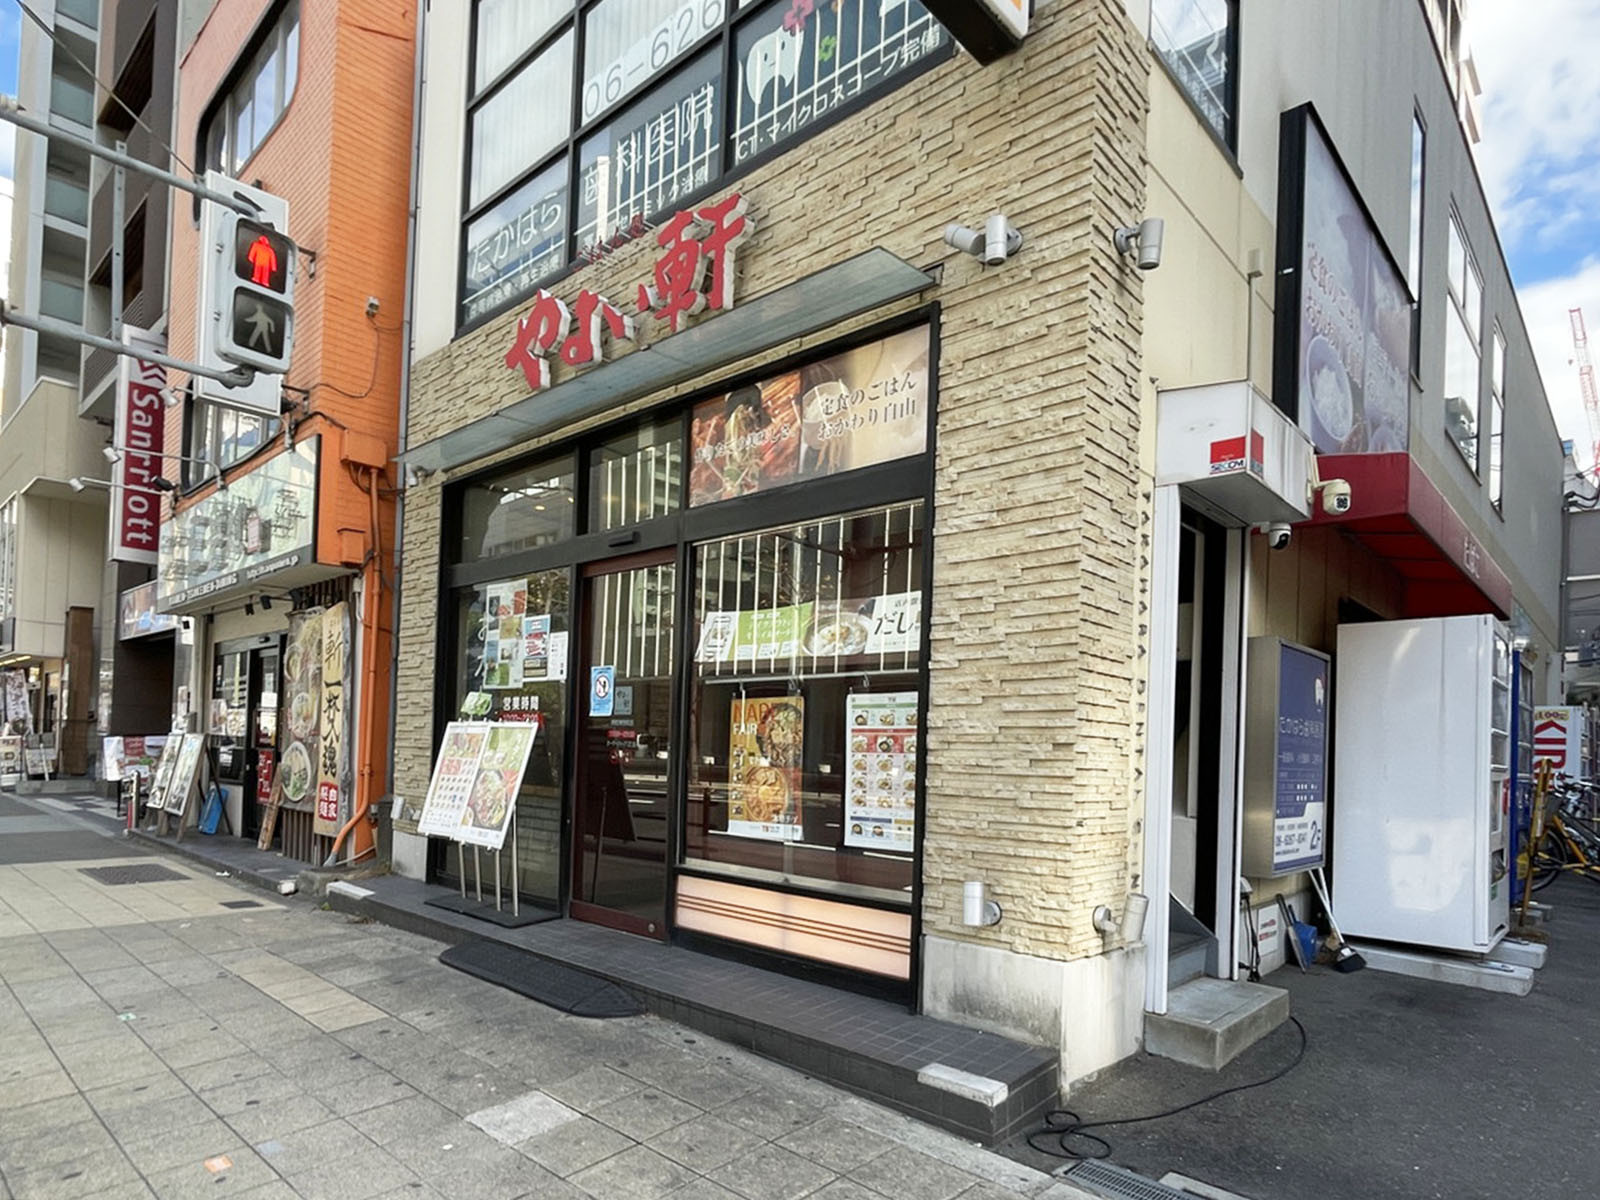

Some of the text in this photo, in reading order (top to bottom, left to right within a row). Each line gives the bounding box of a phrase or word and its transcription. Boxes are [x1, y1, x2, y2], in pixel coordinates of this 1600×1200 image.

[471, 191, 562, 280] たかはら
[125, 388, 160, 544] Sanrriott
[503, 695, 539, 711] 営業時間
